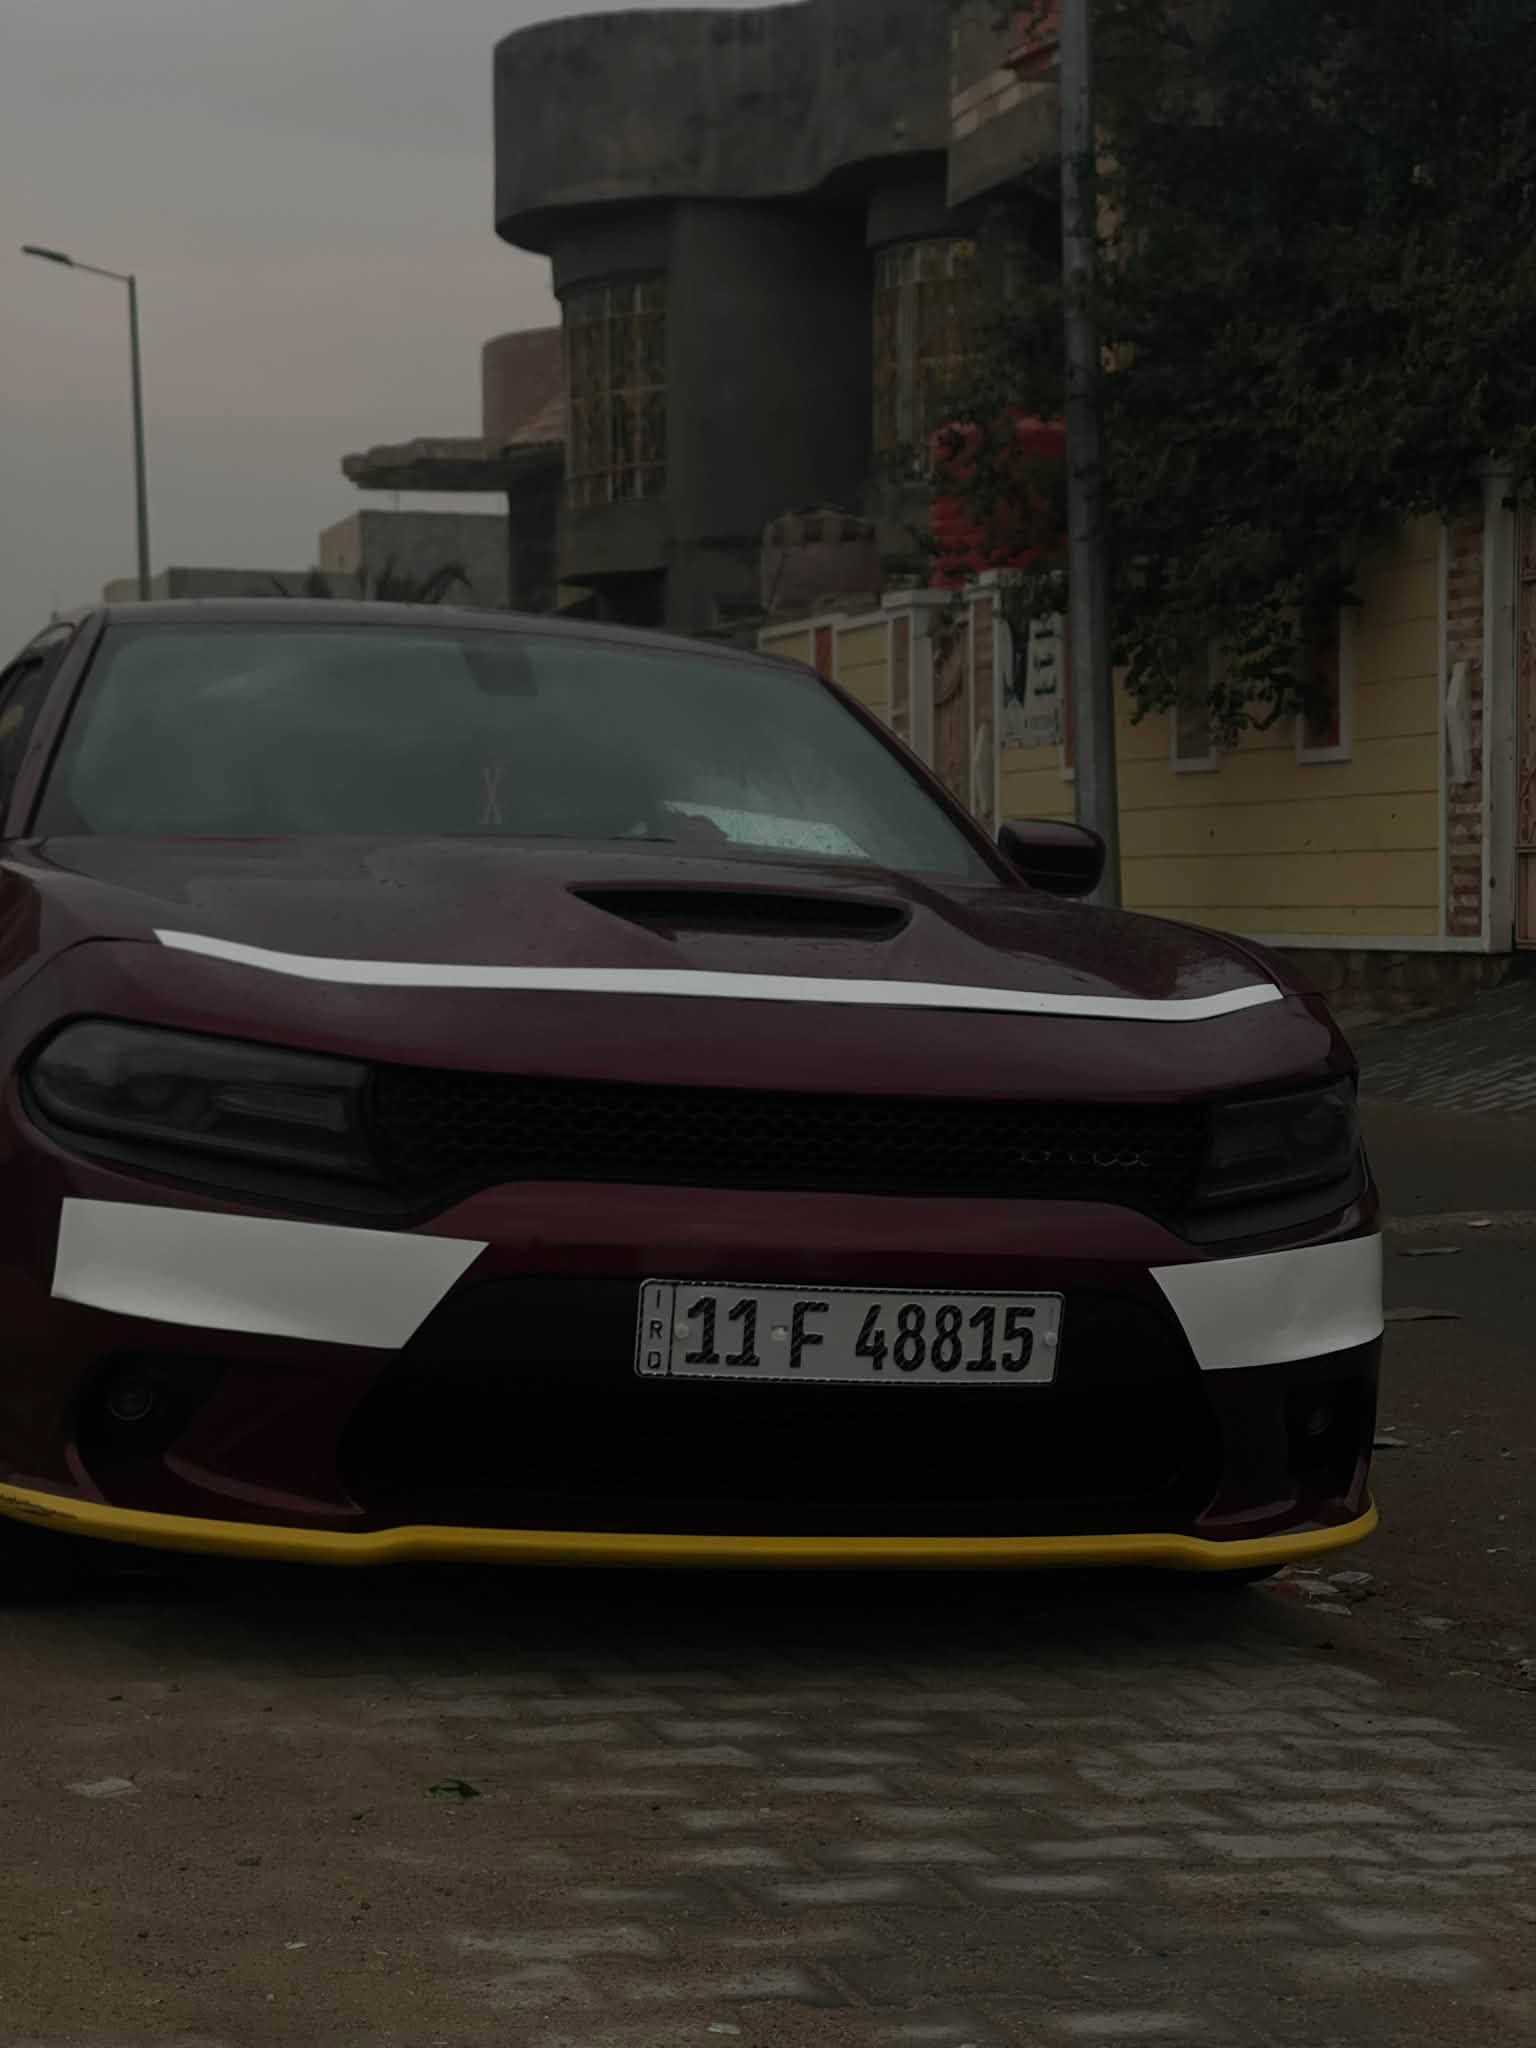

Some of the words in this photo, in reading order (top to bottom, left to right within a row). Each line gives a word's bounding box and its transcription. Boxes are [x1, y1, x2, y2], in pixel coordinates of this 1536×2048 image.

[685, 1296, 760, 1367] 11
[790, 1301, 829, 1368] F
[855, 1303, 1036, 1372] 48815
